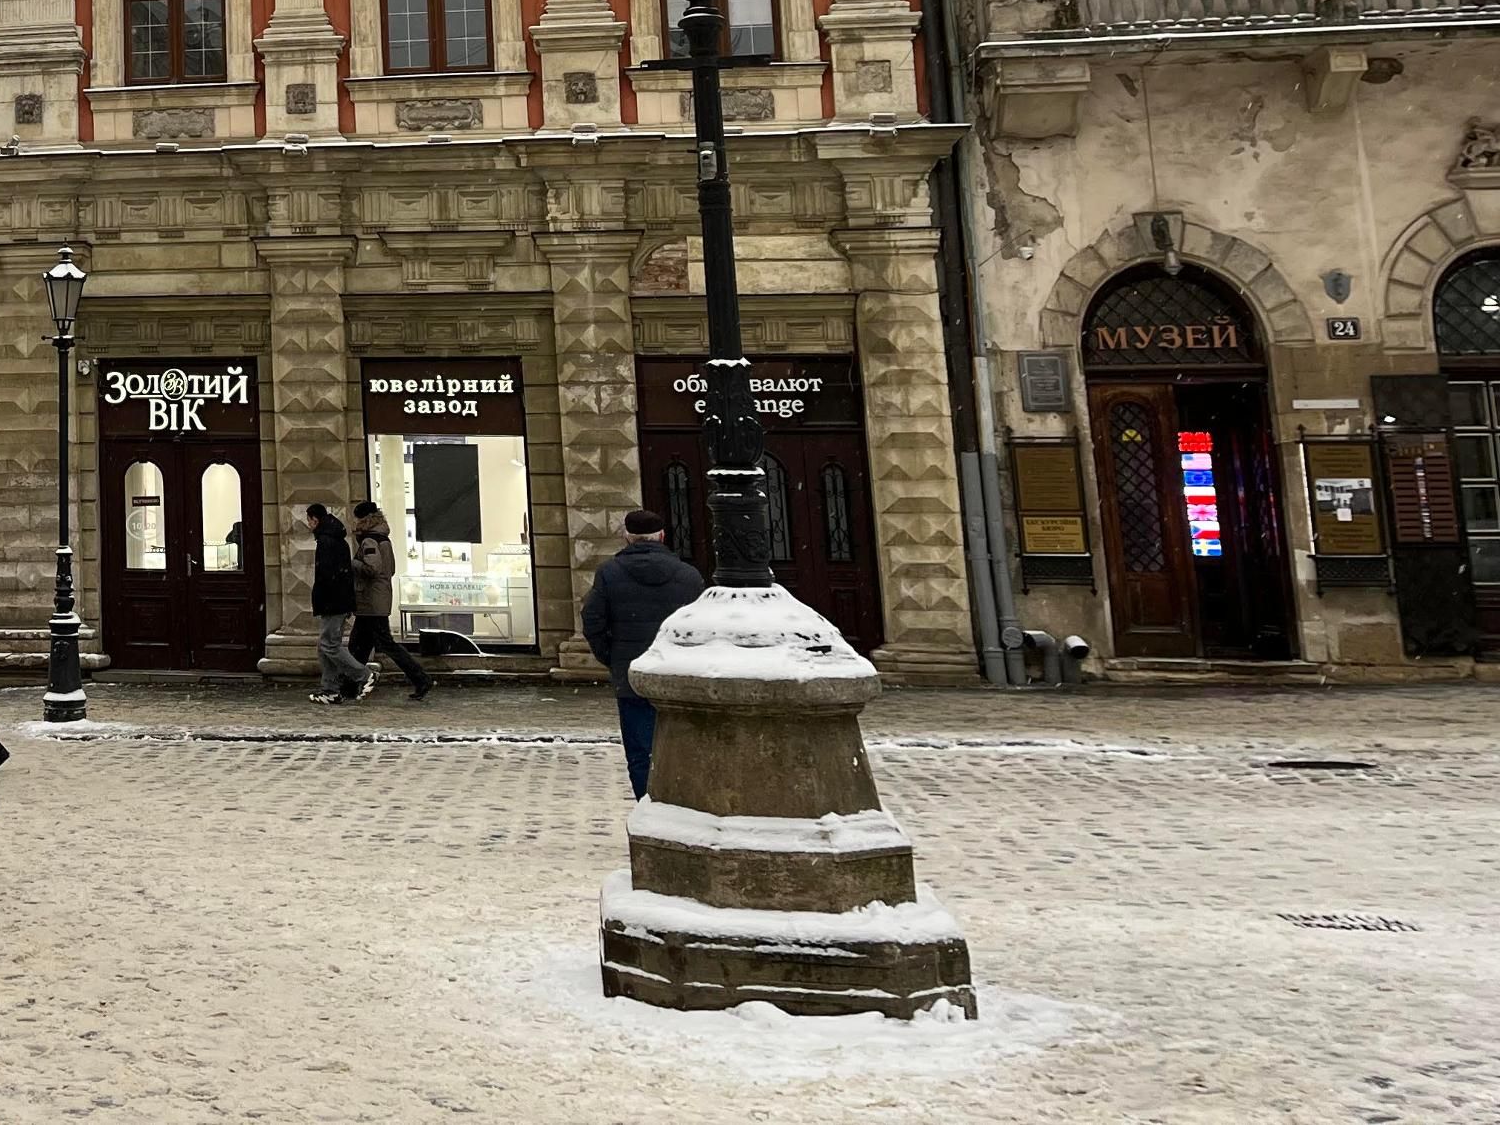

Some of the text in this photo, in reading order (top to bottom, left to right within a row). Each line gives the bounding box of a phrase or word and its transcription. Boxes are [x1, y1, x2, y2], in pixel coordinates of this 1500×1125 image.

[1097, 315, 1238, 349] МУЗЕЙ
[1333, 321, 1356, 336] 24
[369, 374, 515, 397] ювелірний
[749, 378, 824, 392] валют
[148, 399, 207, 431] ВІК
[403, 400, 478, 417] завод
[694, 399, 804, 418] eange
